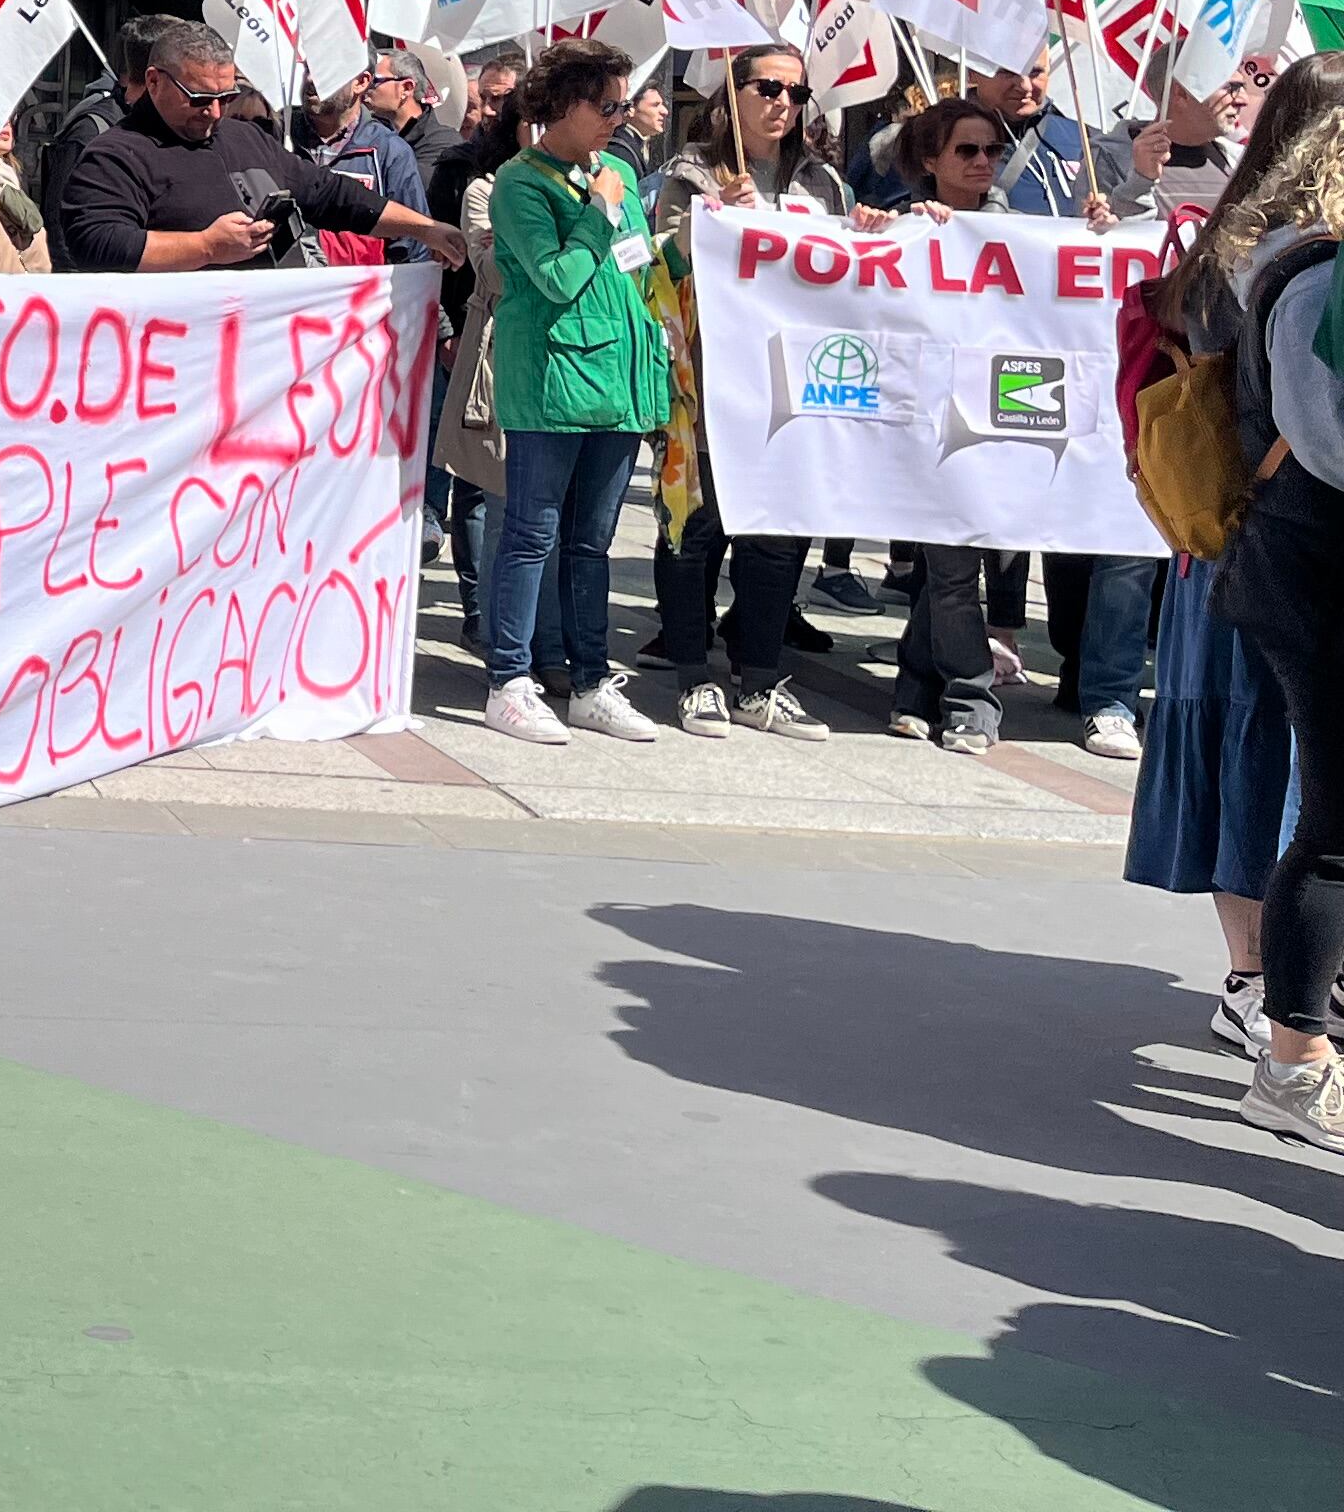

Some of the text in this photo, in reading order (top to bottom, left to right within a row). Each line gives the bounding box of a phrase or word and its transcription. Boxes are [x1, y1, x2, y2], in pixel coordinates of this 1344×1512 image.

[738, 227, 909, 289] POR
[928, 238, 1025, 297] LA
[209, 276, 440, 467] LEÓN
[1001, 359, 1042, 374] ASPES
[801, 383, 881, 408] ANPE
[1037, 413, 1060, 426] León
